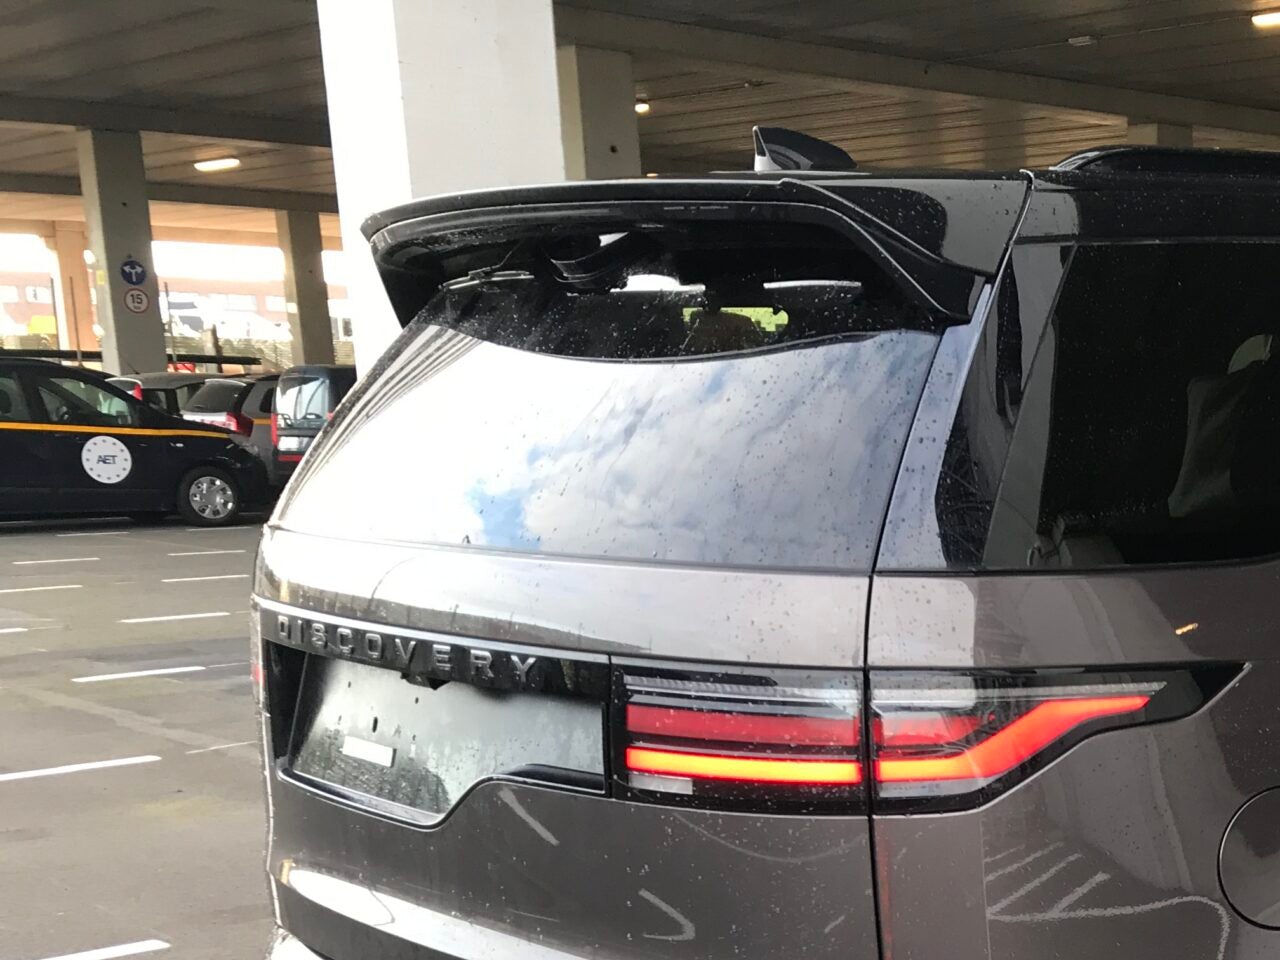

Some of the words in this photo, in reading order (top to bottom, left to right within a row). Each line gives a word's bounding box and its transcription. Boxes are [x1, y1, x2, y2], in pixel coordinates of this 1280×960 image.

[130, 293, 143, 305] 15
[96, 454, 118, 465] AET
[278, 614, 537, 684] DISCOVERY
